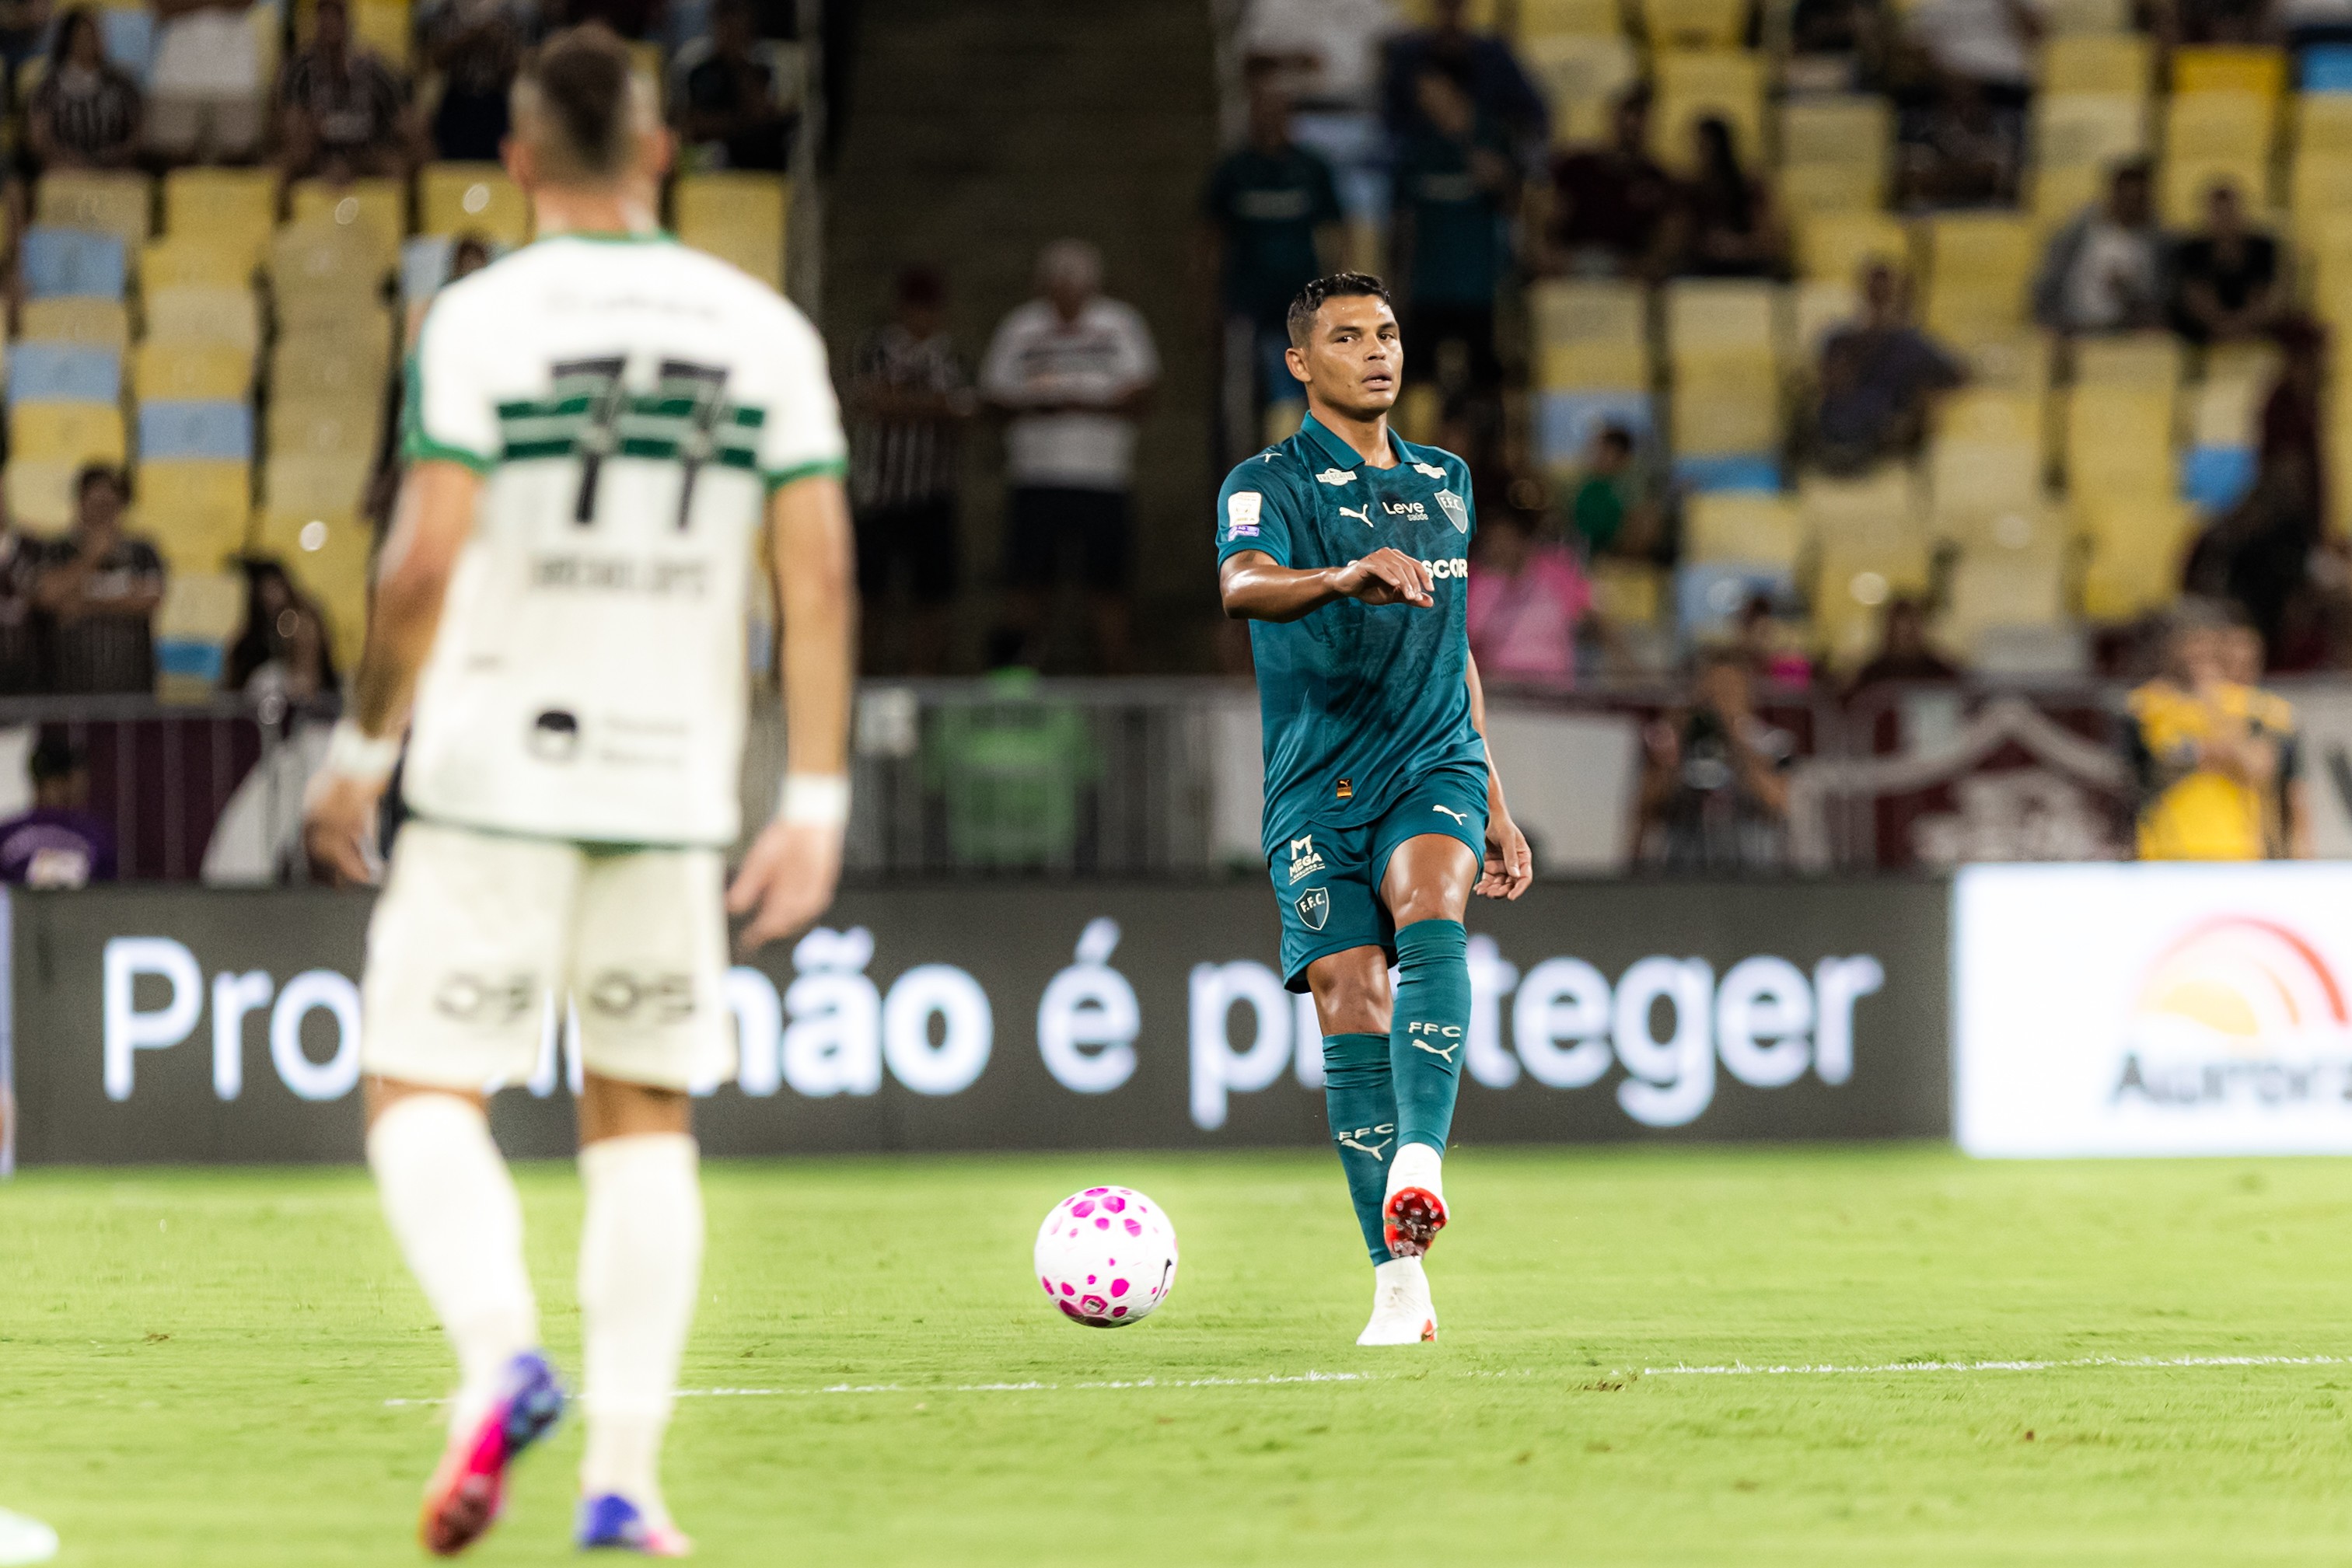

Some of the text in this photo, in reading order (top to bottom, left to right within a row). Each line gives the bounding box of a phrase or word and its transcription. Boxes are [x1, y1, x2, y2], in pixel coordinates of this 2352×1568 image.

[1382, 501, 1424, 515] Leve
[1407, 512, 1429, 522] saúde
[1289, 852, 1323, 878] MEGA
[1036, 918, 1141, 1094] é
[1408, 1021, 1462, 1038] FFC
[1338, 1123, 1394, 1140] FFC
